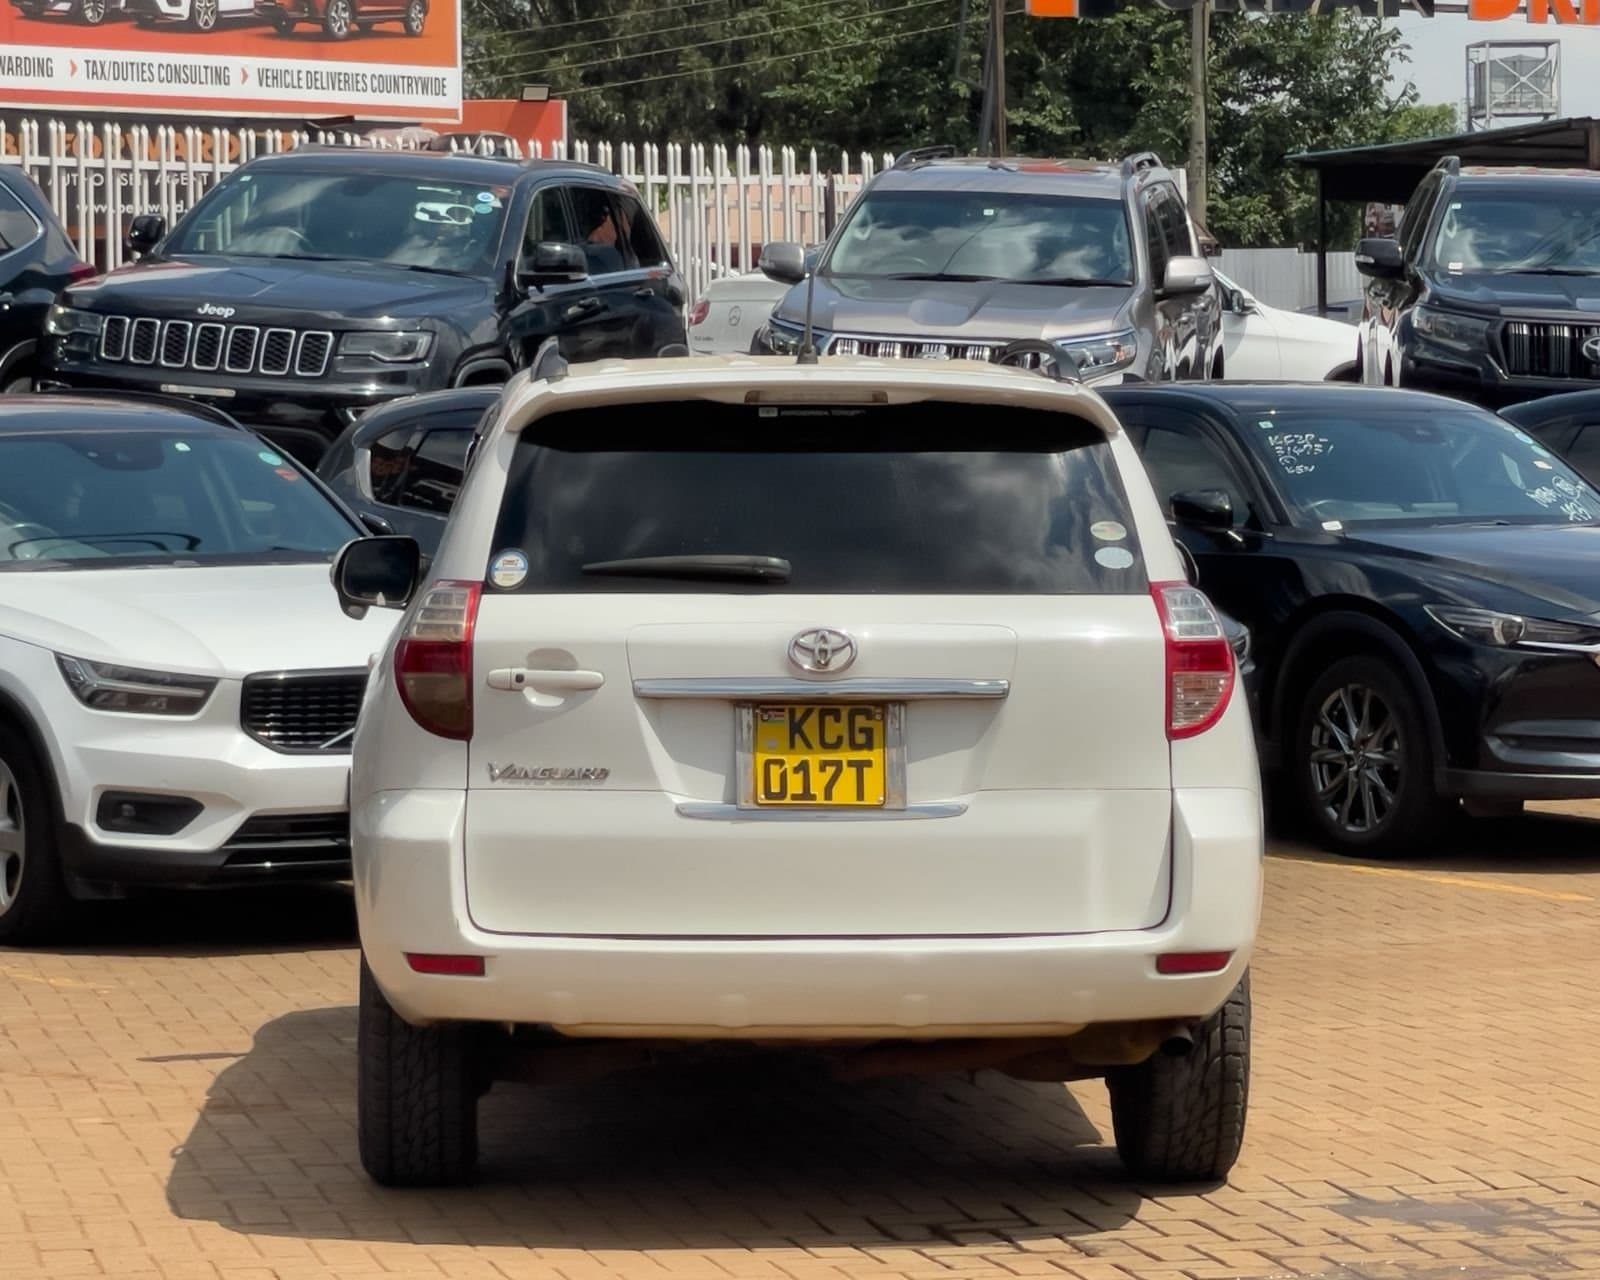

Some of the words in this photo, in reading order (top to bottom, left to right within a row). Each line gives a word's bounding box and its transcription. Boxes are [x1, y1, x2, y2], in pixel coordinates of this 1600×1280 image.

[84, 59, 155, 82] TAX/DUTIES
[157, 64, 230, 86] CONSULTING
[257, 67, 303, 89] VEHICLE
[305, 70, 368, 93] DELIVERIES
[370, 74, 447, 97] COUNTRYWIDE
[197, 303, 235, 318] Jeep
[788, 707, 874, 751] KCG
[764, 758, 874, 801] 017T
